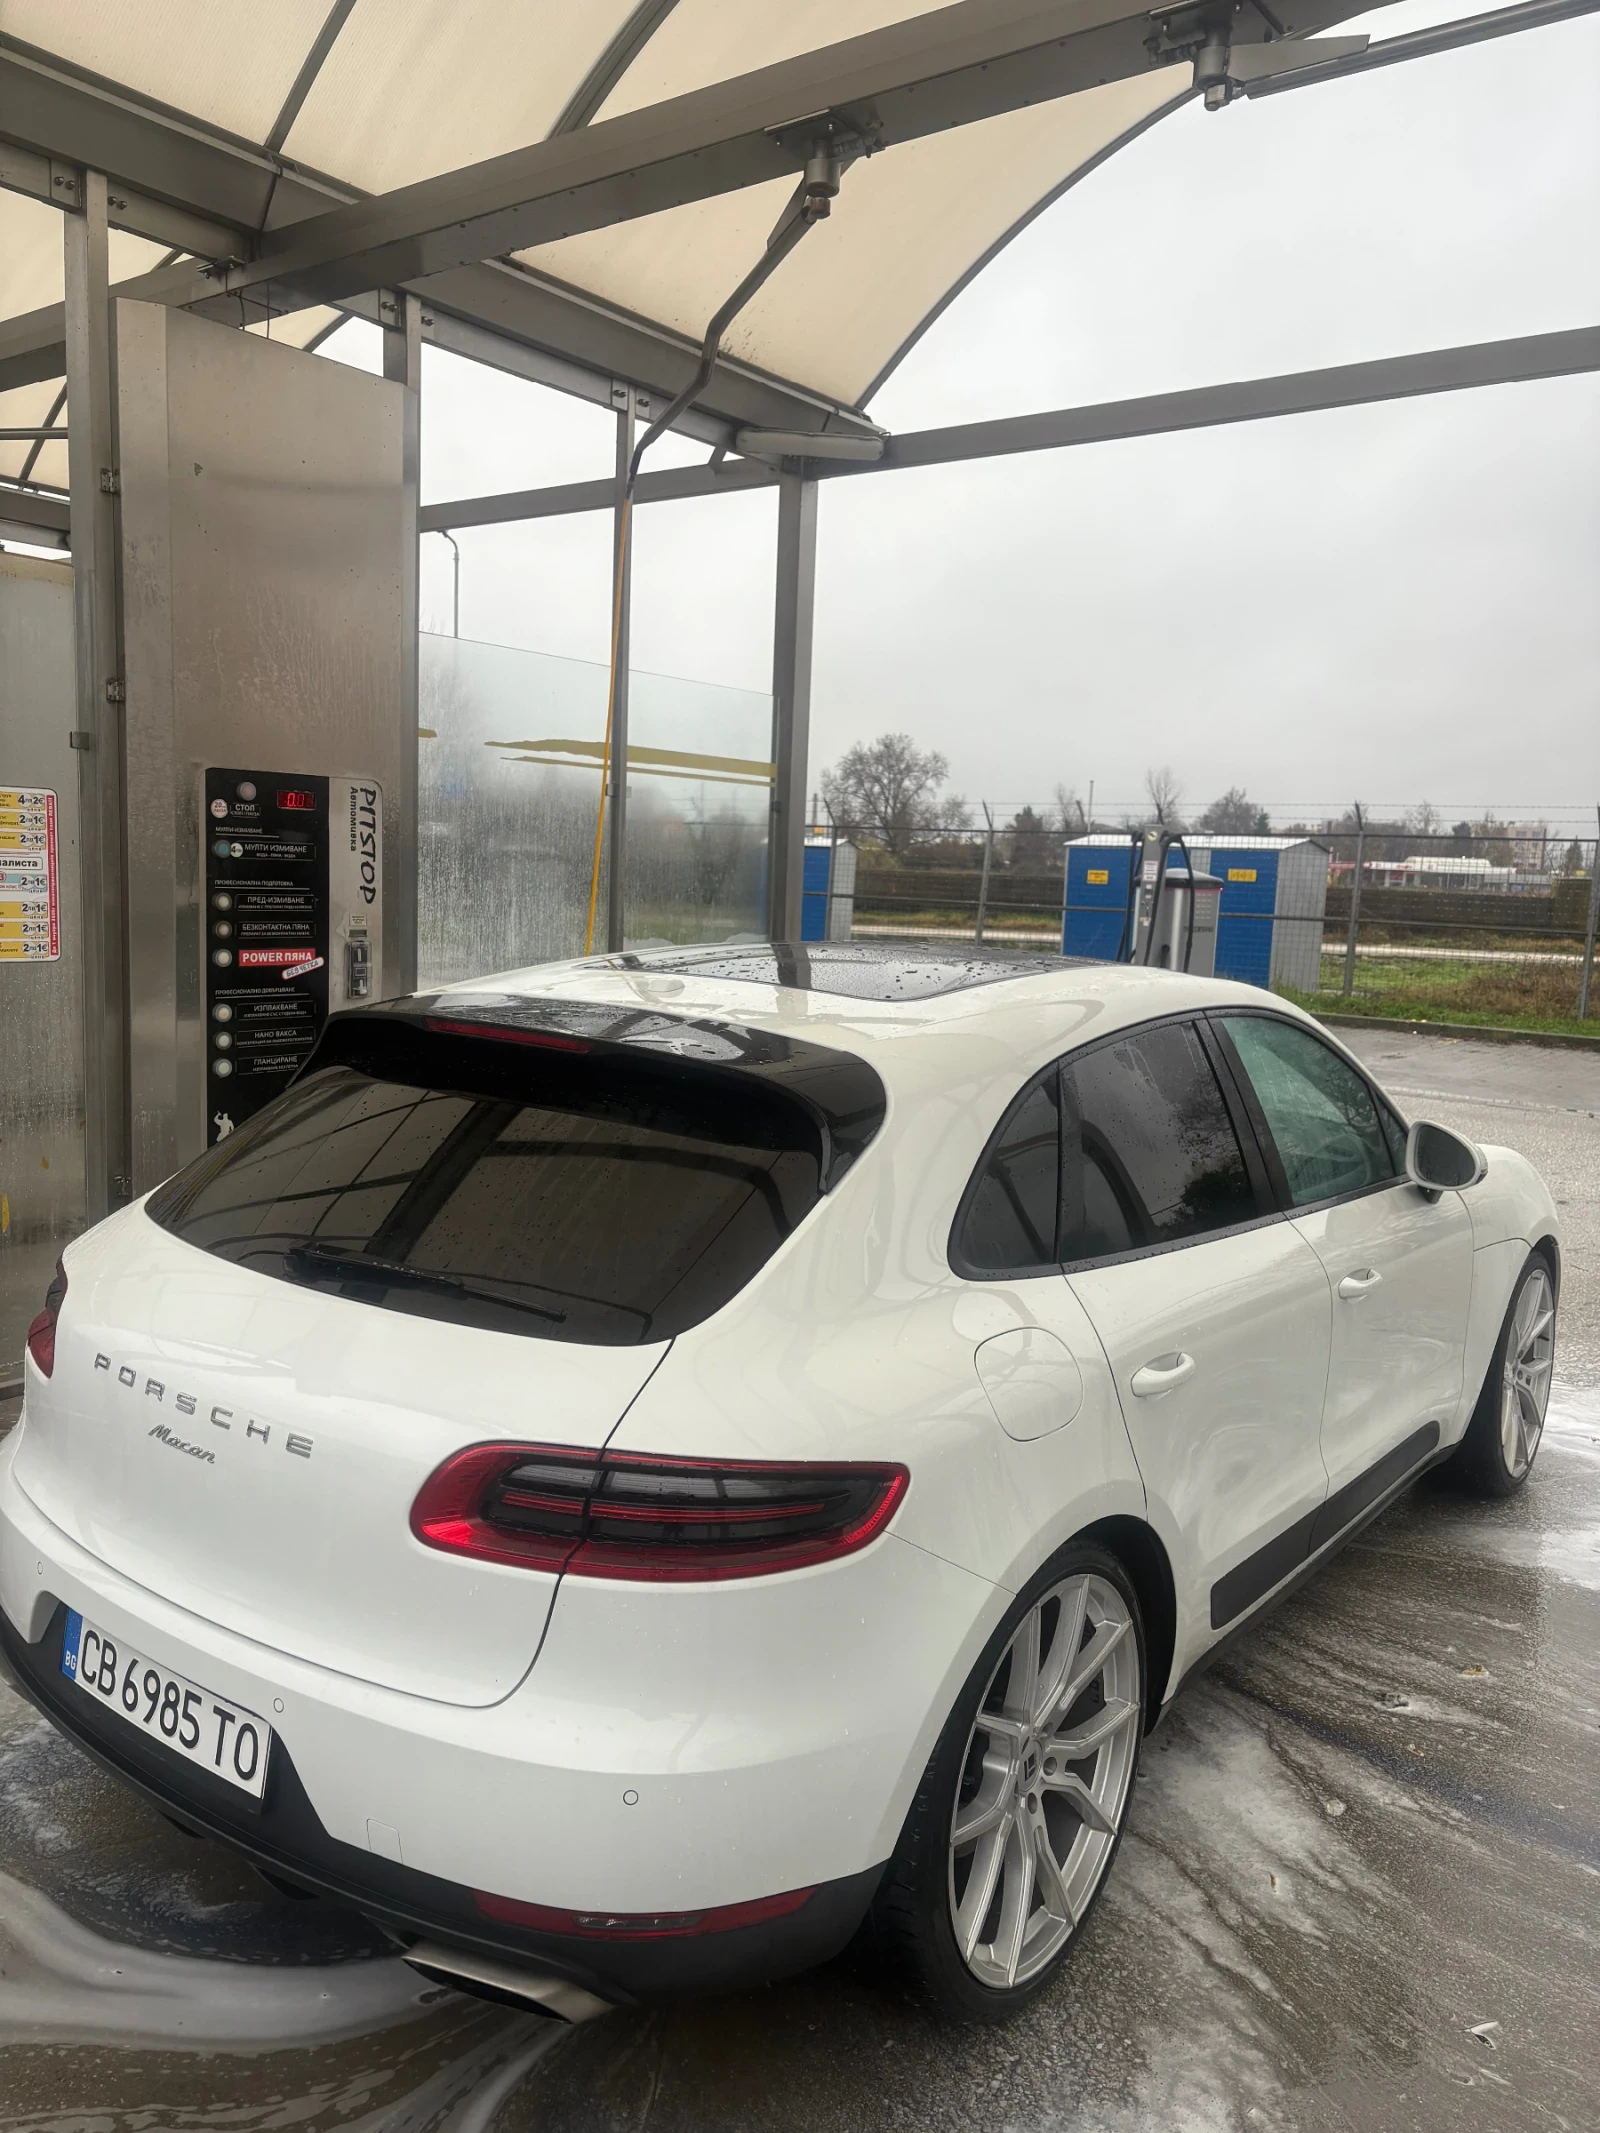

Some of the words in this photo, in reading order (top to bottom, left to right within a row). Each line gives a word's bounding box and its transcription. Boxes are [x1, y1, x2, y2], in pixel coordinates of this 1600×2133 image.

[34, 796, 44, 804] 2€
[235, 803, 255, 812] СТОП
[34, 816, 44, 824] 1€
[350, 786, 358, 852] Автомивка
[34, 835, 45, 844] 1€
[244, 843, 269, 851] МУЛТИ
[270, 844, 307, 853] ИЗМИВАНЕ
[360, 787, 376, 904] PITSTOP
[35, 877, 46, 886] 1€
[247, 896, 305, 904] ПРЕД-ИЗМИВАНЕ
[36, 904, 46, 912] 1€
[36, 924, 47, 932] 1€
[242, 923, 291, 931] БЕЗКОНТАКТНА
[292, 923, 310, 931] ПЯНА
[37, 944, 48, 952] 1€
[242, 952, 282, 963] POWER
[284, 952, 312, 962] ПЯНА
[253, 1003, 298, 1012] ИЗПЛАКВАНЕ
[275, 1029, 297, 1037] ВАКСА
[253, 1055, 298, 1066] ГЛАНЦИРАНЕ
[94, 1352, 313, 1459] PORSCHE
[148, 1422, 216, 1465] Macan
[64, 1650, 77, 1671] BG
[81, 1629, 118, 1696] CB
[121, 1658, 203, 1750] 6985
[212, 1704, 259, 1781] TO
